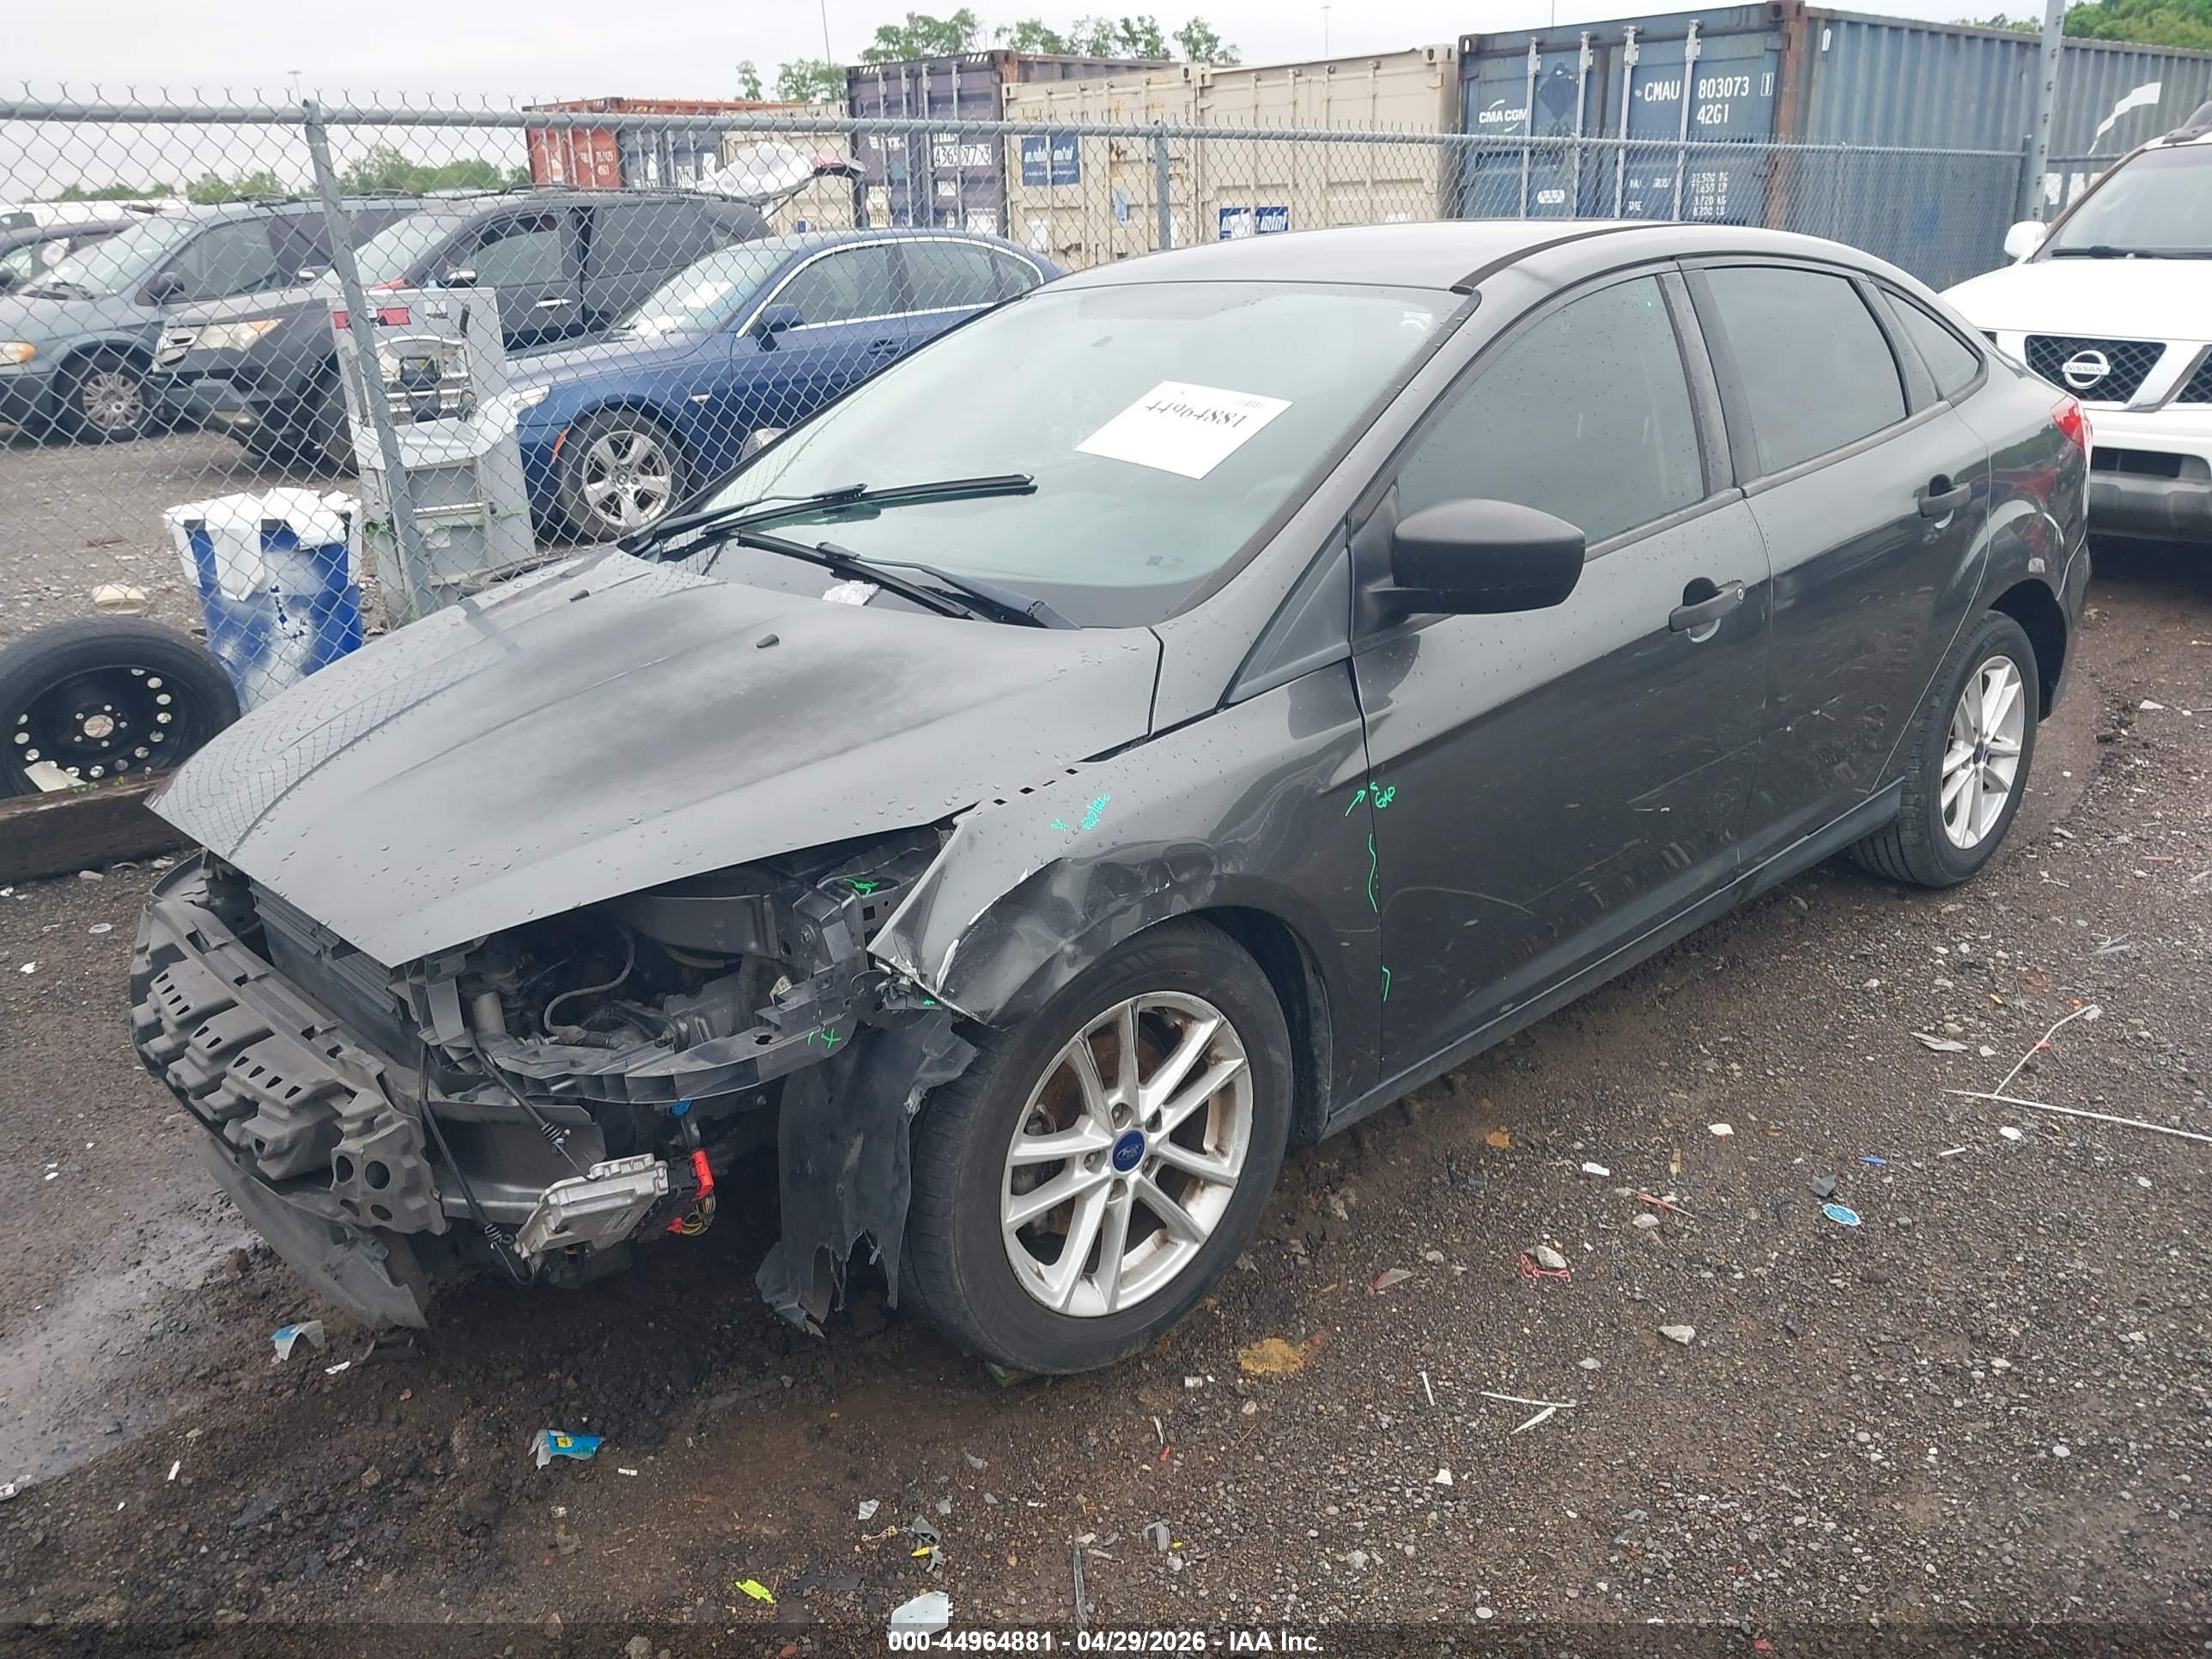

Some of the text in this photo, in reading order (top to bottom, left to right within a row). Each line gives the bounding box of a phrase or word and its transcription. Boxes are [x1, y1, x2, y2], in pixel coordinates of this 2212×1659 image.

[1644, 80, 1680, 101] CMAU
[1698, 76, 1750, 100] 803073
[1479, 108, 1527, 124] CMA CGM
[1697, 103, 1729, 124] 42G1
[1260, 210, 1288, 232] mini
[1145, 400, 1248, 428] 44964881
